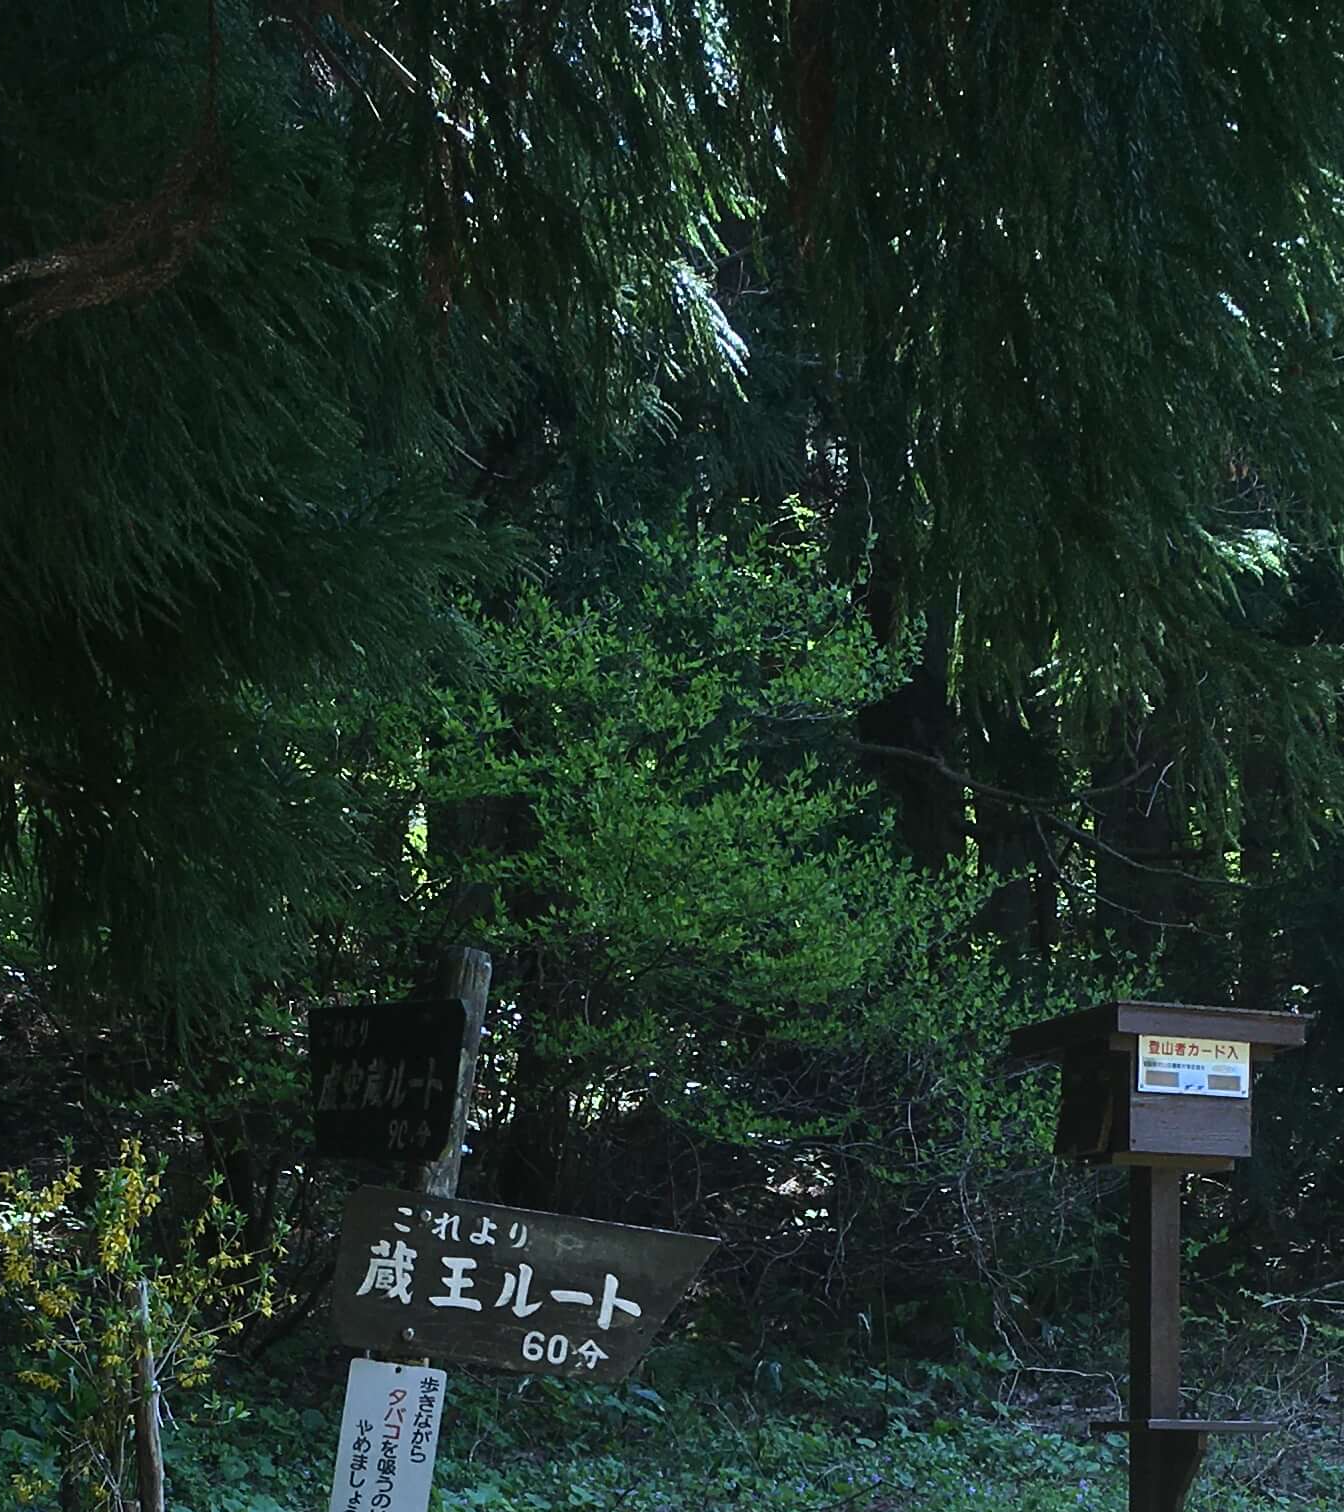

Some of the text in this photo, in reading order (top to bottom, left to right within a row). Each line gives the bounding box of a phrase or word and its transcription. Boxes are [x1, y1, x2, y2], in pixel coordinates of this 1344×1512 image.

[1148, 1040, 1238, 1060] 登山者カード入
[394, 1207, 528, 1249] これより
[356, 1240, 642, 1330] 蔵王ルート
[522, 1330, 610, 1369] 60分
[410, 1376, 440, 1463] 歩きながら
